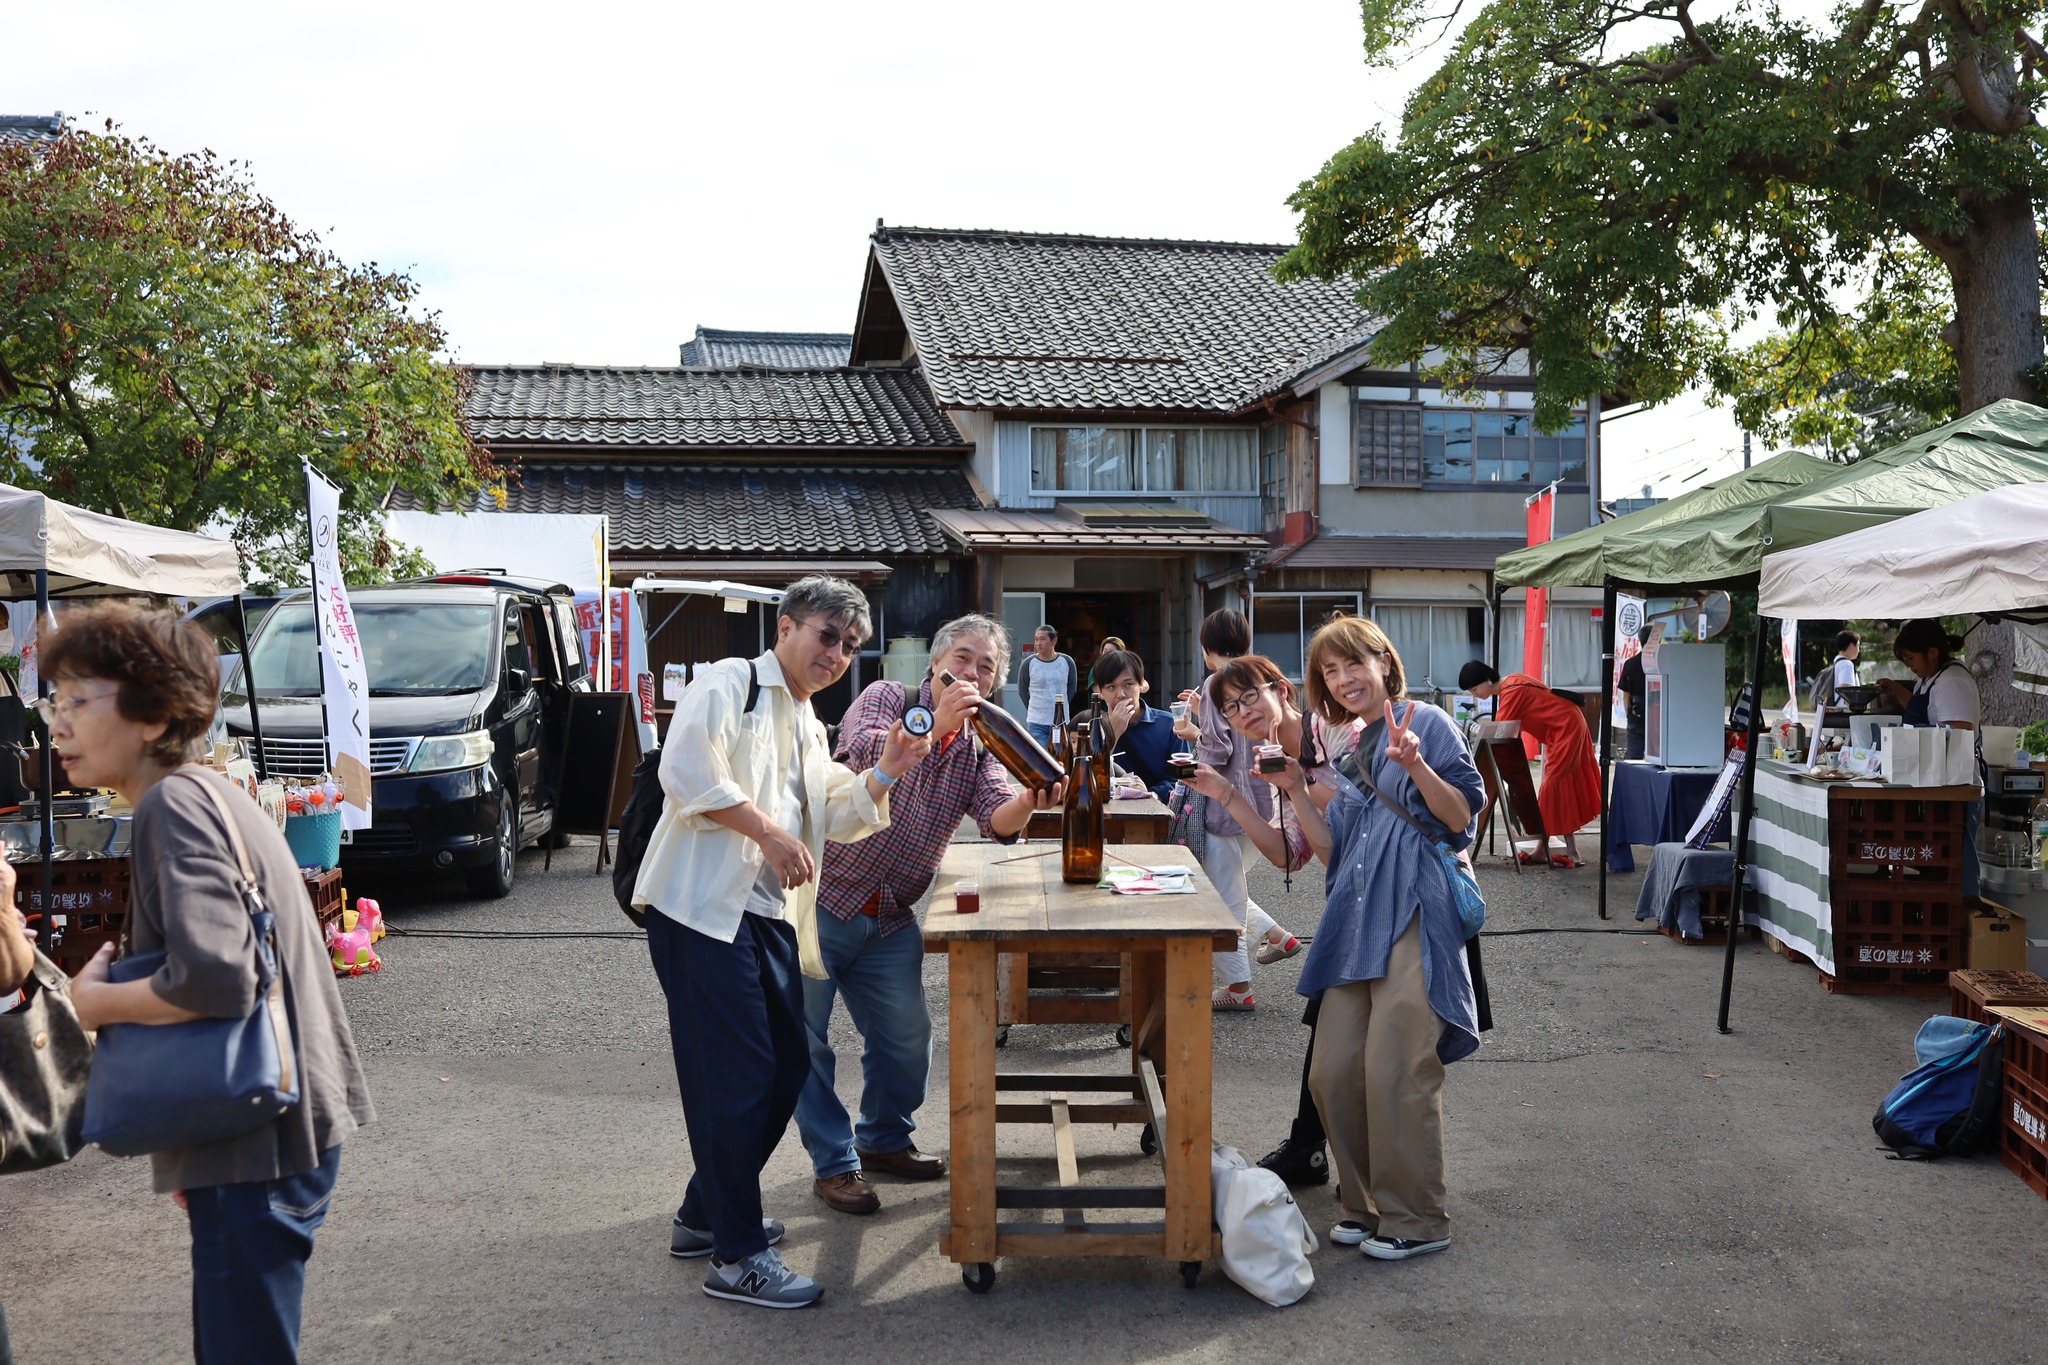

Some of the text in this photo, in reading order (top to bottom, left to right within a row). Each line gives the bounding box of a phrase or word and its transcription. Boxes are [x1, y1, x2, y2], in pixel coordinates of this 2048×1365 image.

[318, 579, 363, 738] こんにゃく
[1858, 947, 1915, 965] 新潟の酒
[738, 1268, 770, 1297] N
